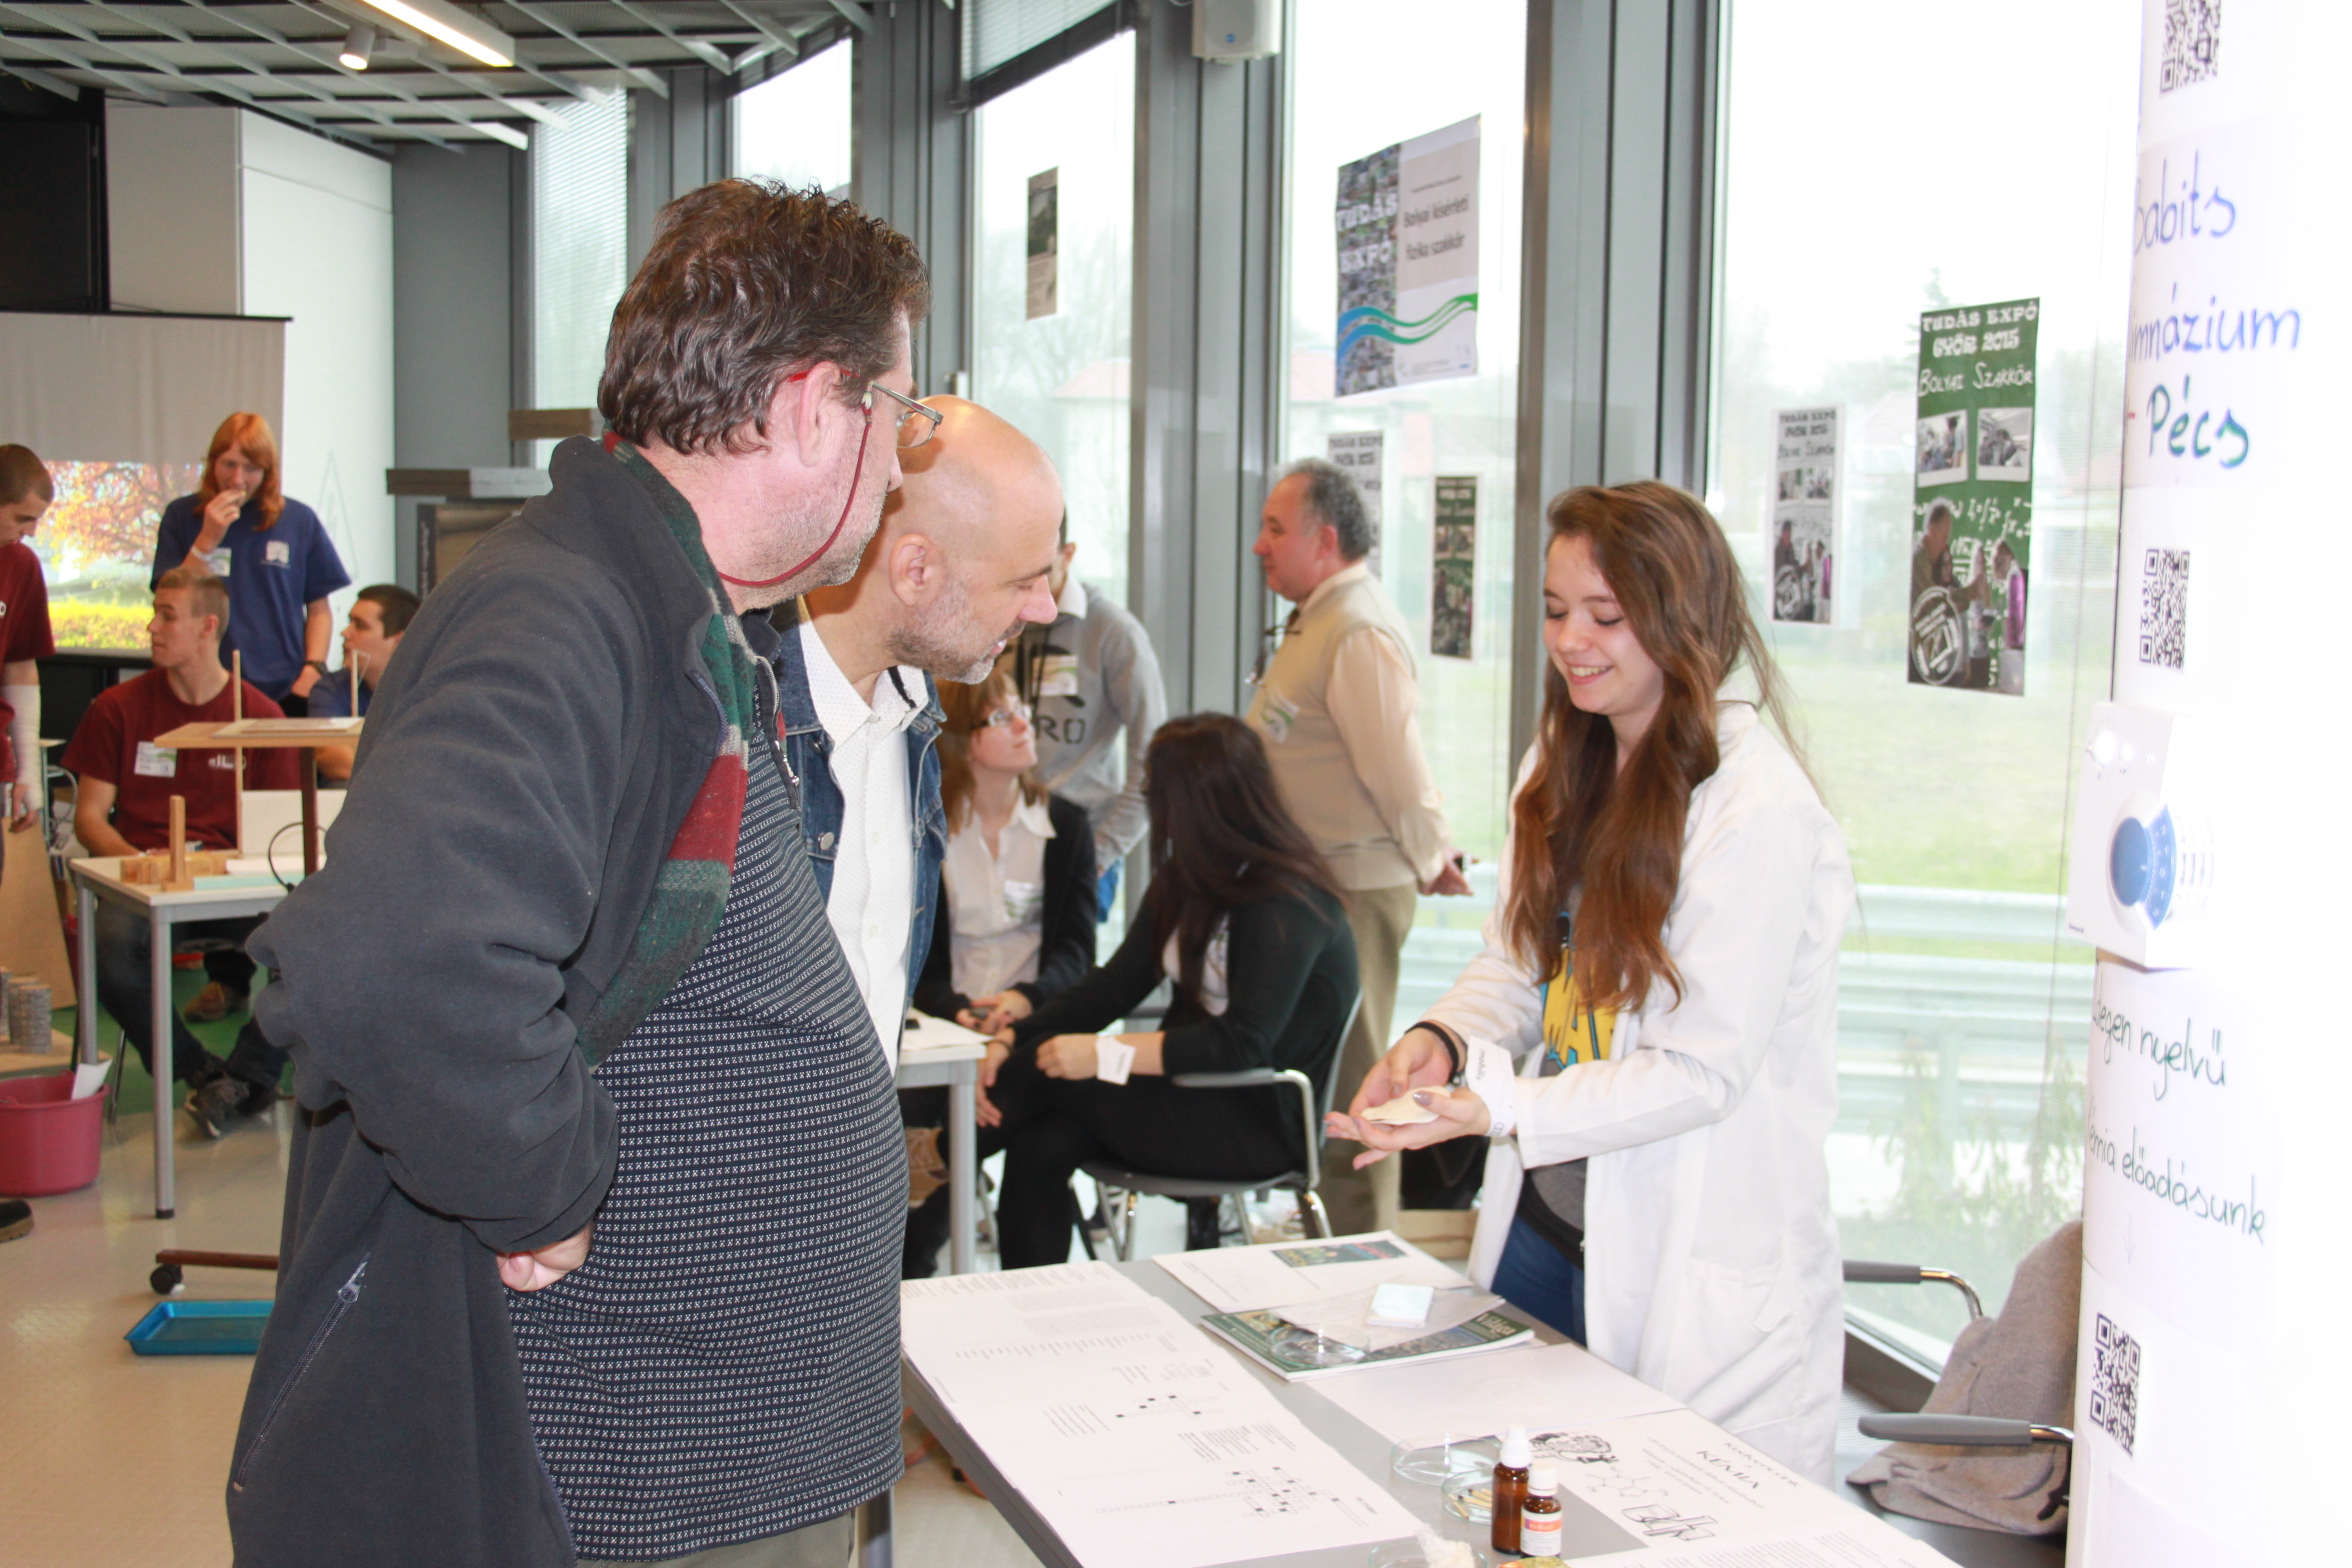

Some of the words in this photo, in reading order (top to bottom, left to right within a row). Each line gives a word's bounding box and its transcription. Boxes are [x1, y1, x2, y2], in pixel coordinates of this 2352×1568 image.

[1923, 309, 1980, 332] TUDÁS
[1986, 301, 2038, 325] EXPÓ
[1982, 328, 2020, 352] 2015
[2128, 282, 2301, 364] imnázium
[2146, 374, 2250, 469] Pécs
